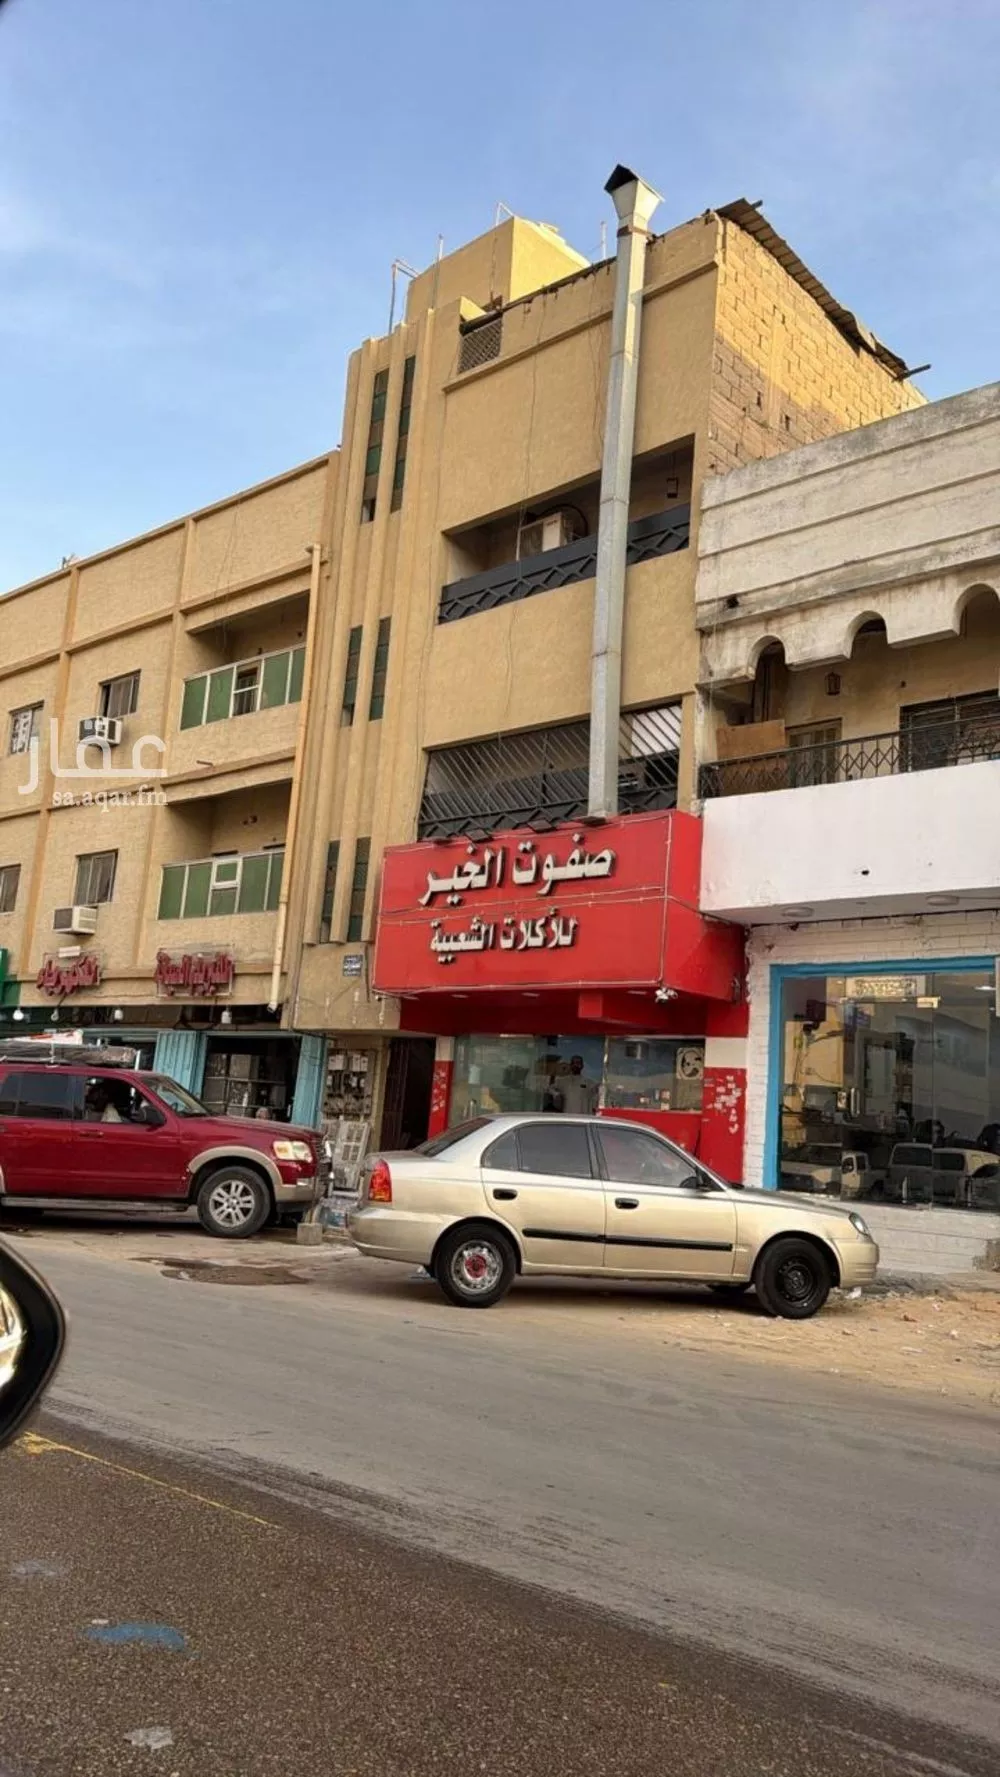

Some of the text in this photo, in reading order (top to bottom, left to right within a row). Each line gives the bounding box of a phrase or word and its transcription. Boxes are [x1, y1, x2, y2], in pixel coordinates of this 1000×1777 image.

[418, 833, 615, 906] صفوت الخير
[430, 907, 578, 964] للأكلات الشعبية
